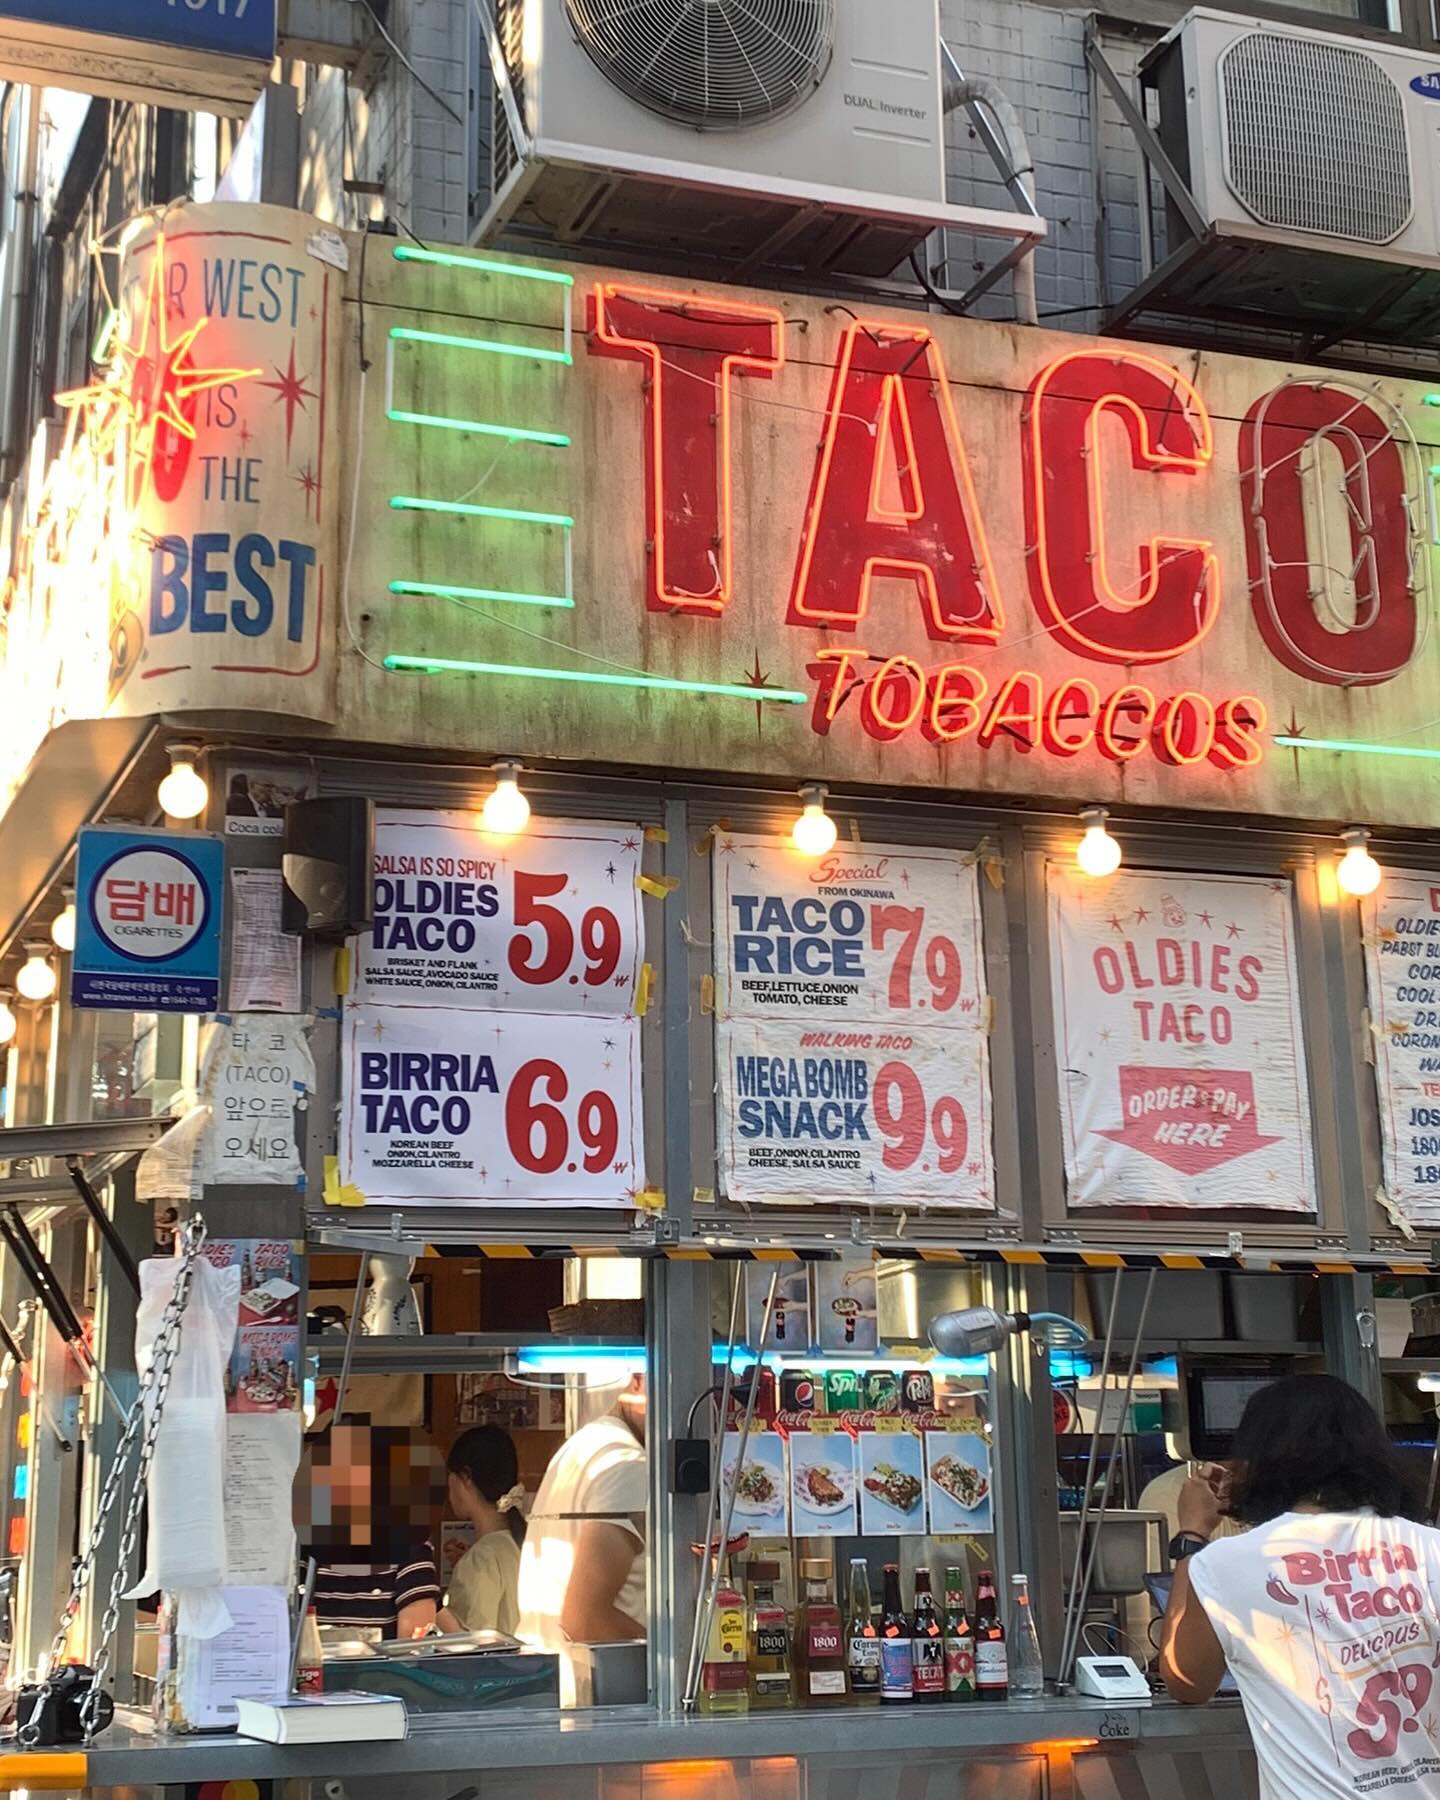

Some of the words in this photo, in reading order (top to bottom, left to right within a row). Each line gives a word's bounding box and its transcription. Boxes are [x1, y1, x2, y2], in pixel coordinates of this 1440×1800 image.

[843, 93, 879, 111] DUAL
[880, 101, 927, 120] Inverter
[203, 257, 306, 329] WEST
[205, 383, 239, 429] IS
[198, 456, 263, 504] THE
[586, 283, 1428, 688] TACO
[149, 532, 316, 643] BEST
[806, 648, 1267, 770] TOBACCOS
[228, 821, 259, 834] Coca
[374, 854, 417, 875] SALSA
[420, 857, 434, 876] IS
[437, 857, 454, 877] SO
[457, 858, 497, 881] SPICY
[809, 857, 889, 885] Special
[106, 879, 196, 925] 담배
[374, 879, 500, 917] OLDIES
[818, 886, 848, 897] FROM
[849, 887, 895, 900] OKINAWA
[114, 925, 184, 939] CIGARETTES
[373, 915, 476, 953] TACO
[508, 870, 621, 986] 5.9
[731, 895, 865, 937] TACO
[387, 957, 426, 967] BRISKET
[428, 959, 446, 968] AND
[447, 960, 479, 970] FLANK
[733, 935, 866, 978] RICE
[870, 903, 962, 1012] 7.9
[1381, 940, 1424, 957] PABST
[365, 967, 394, 976] SALSA
[470, 972, 499, 981] SAUCE
[365, 977, 393, 986] WHITE
[1092, 938, 1264, 1002] OLDIES
[752, 992, 802, 1006] TOMATO,
[803, 995, 849, 1006] CHEESE
[800, 1031, 873, 1049] WALKING
[875, 1034, 913, 1050] TACO
[1133, 1000, 1232, 1045] TACO
[226, 1065, 291, 1085] (TACO)
[361, 1052, 499, 1094] BIRRIA
[736, 1056, 801, 1098] MEGA
[804, 1057, 868, 1100] BOMB
[224, 1096, 291, 1121] 앞으로
[361, 1094, 471, 1135] TACO
[505, 1058, 619, 1174] 6.9
[738, 1099, 871, 1141] SNACK
[872, 1060, 968, 1174] 9.9
[1128, 1084, 1197, 1118] ORDER
[1211, 1087, 1250, 1121] PAY
[222, 1137, 290, 1162] 오세요
[390, 1140, 429, 1149] KOREAN
[431, 1141, 454, 1150] BEEF
[1153, 1121, 1231, 1148] HERE
[1411, 1136, 1440, 1156] 180
[372, 1159, 436, 1169] MOZZARELLA
[438, 1160, 474, 1170] CHEESE
[792, 1159, 825, 1169] SALSA
[828, 1160, 861, 1169] SAUCE
[1282, 1541, 1418, 1586] Birria
[1324, 1582, 1424, 1623] Taco
[759, 1636, 785, 1649] 1800
[813, 1637, 837, 1649] 1800
[1099, 1723, 1130, 1738] Coke
